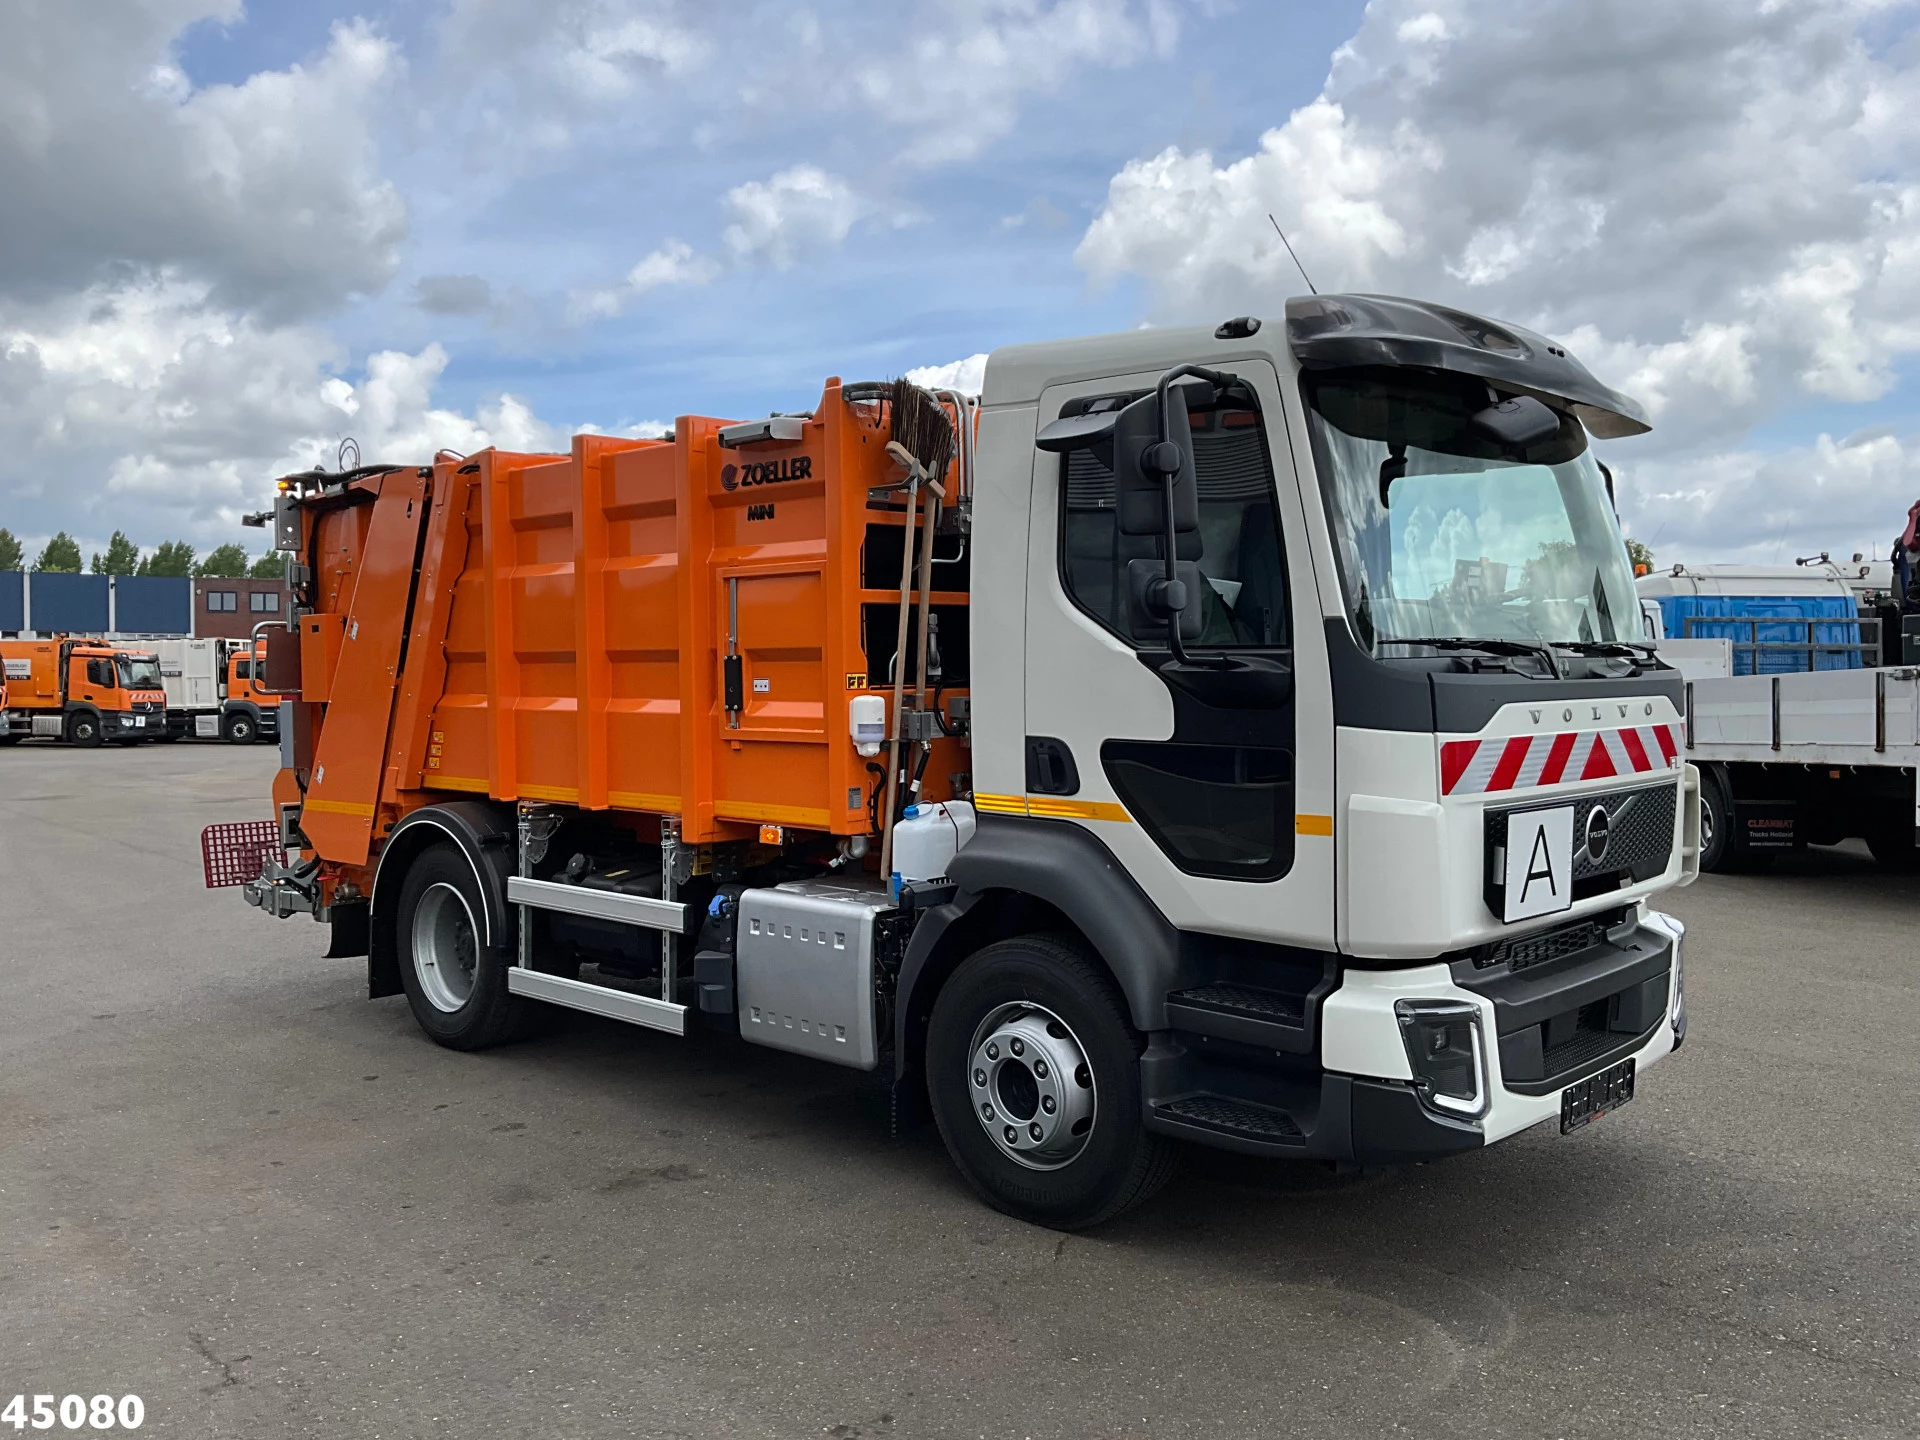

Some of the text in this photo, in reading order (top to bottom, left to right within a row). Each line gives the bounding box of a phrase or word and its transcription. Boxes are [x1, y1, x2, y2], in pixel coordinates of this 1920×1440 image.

[741, 456, 812, 487] ZOELLER
[747, 503, 775, 522] MINI
[1529, 702, 1653, 725] VOLVO
[1669, 756, 1680, 770] FL
[1747, 819, 1793, 829] CLEANMAT
[1589, 829, 1608, 839] VOLVO
[1520, 824, 1557, 903] A
